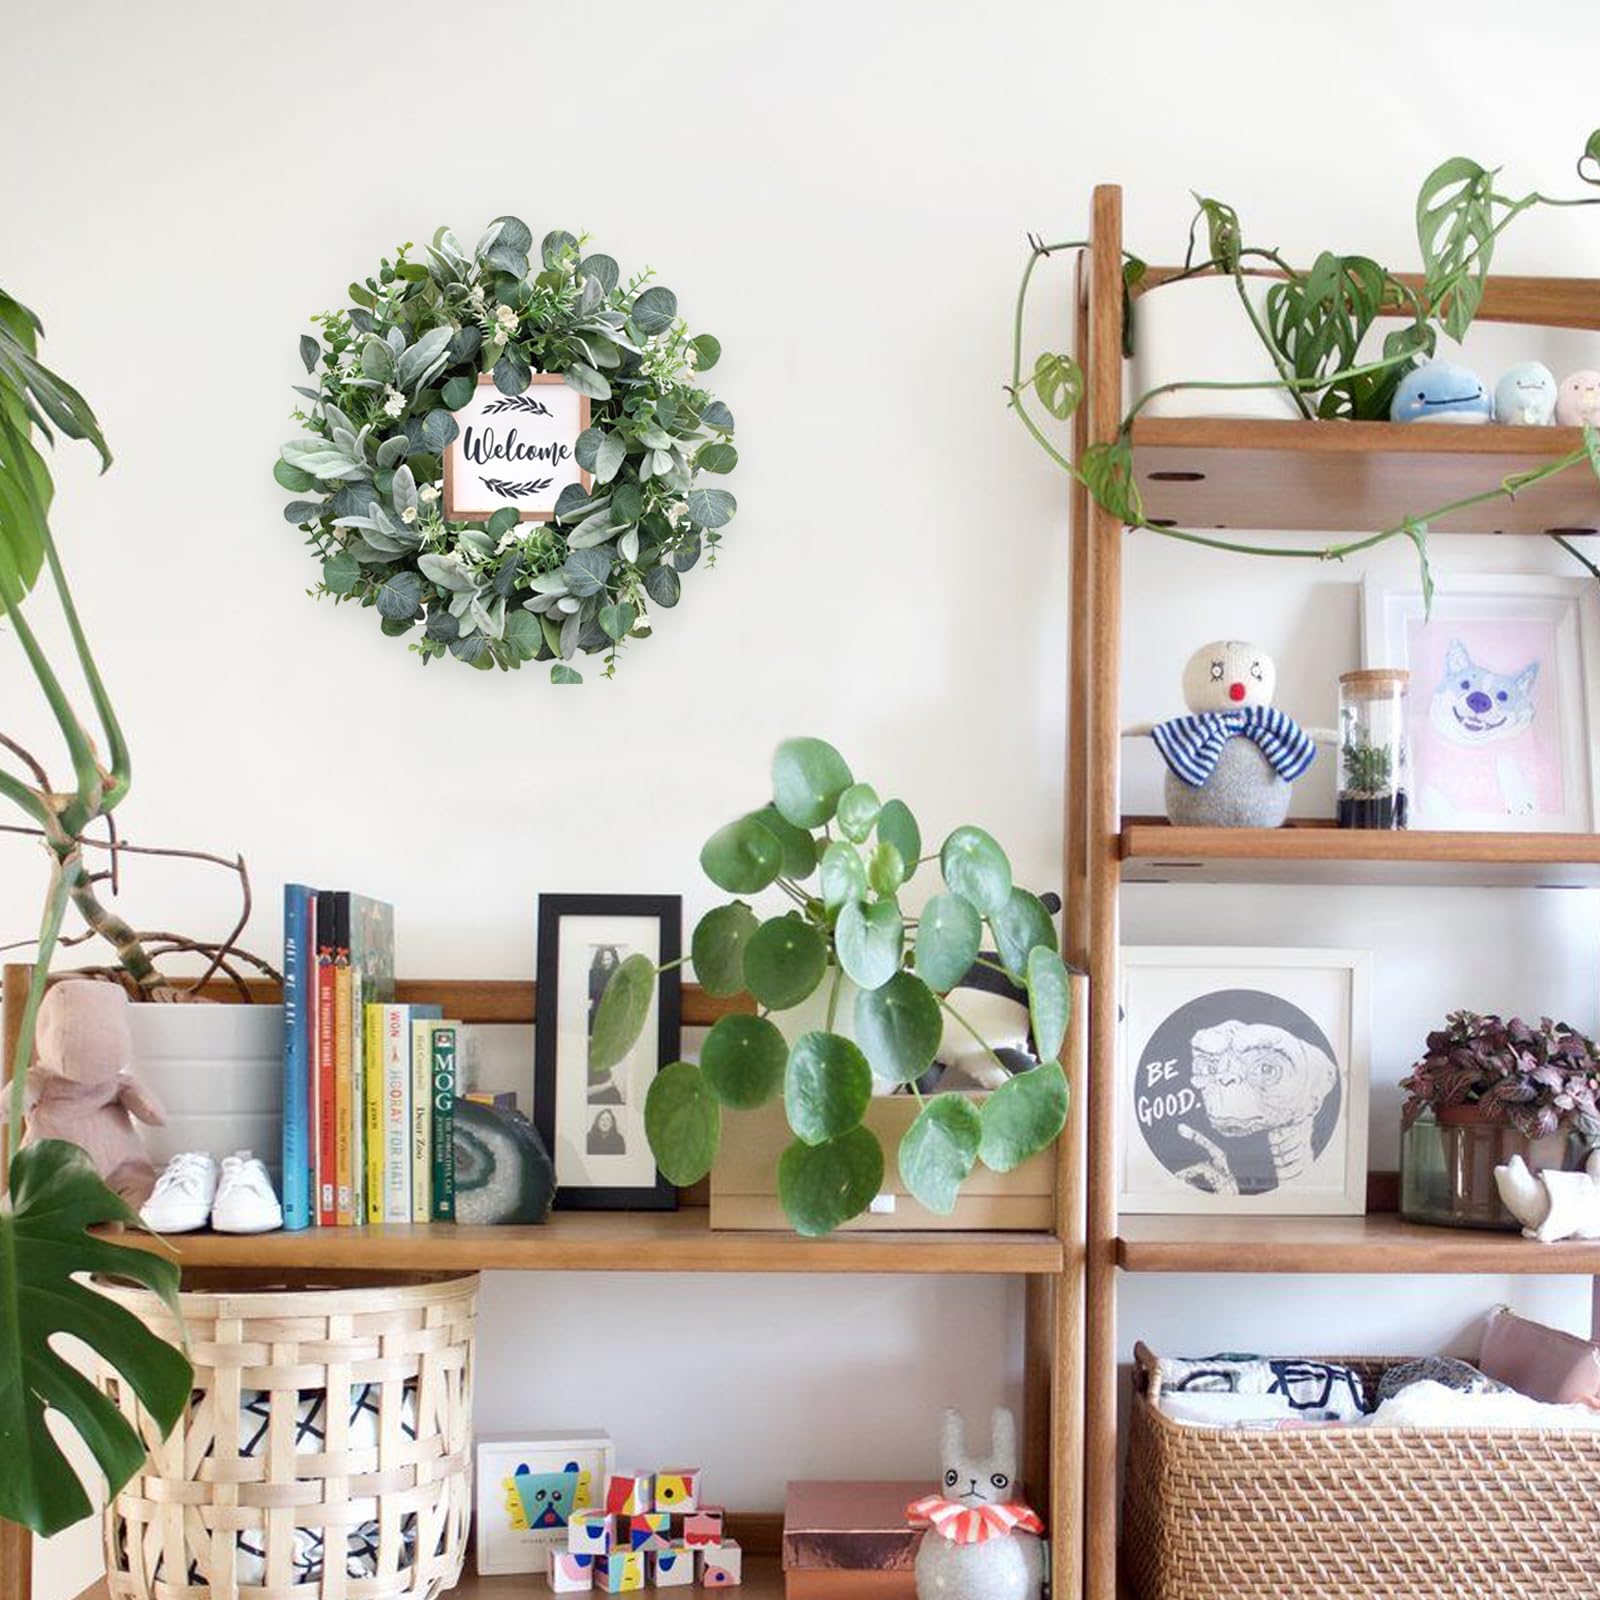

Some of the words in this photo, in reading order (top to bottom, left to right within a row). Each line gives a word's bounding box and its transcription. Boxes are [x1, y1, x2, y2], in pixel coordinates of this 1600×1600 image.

[463, 425, 573, 467] Welcome
[390, 1011, 400, 1037] WON
[435, 1053, 455, 1111] MOG
[1146, 1058, 1179, 1087] BE
[416, 1107, 425, 1134] Dear
[1138, 1088, 1201, 1126] GOOD.
[391, 1130, 402, 1156] FOR
[416, 1138, 426, 1160] Zoo
